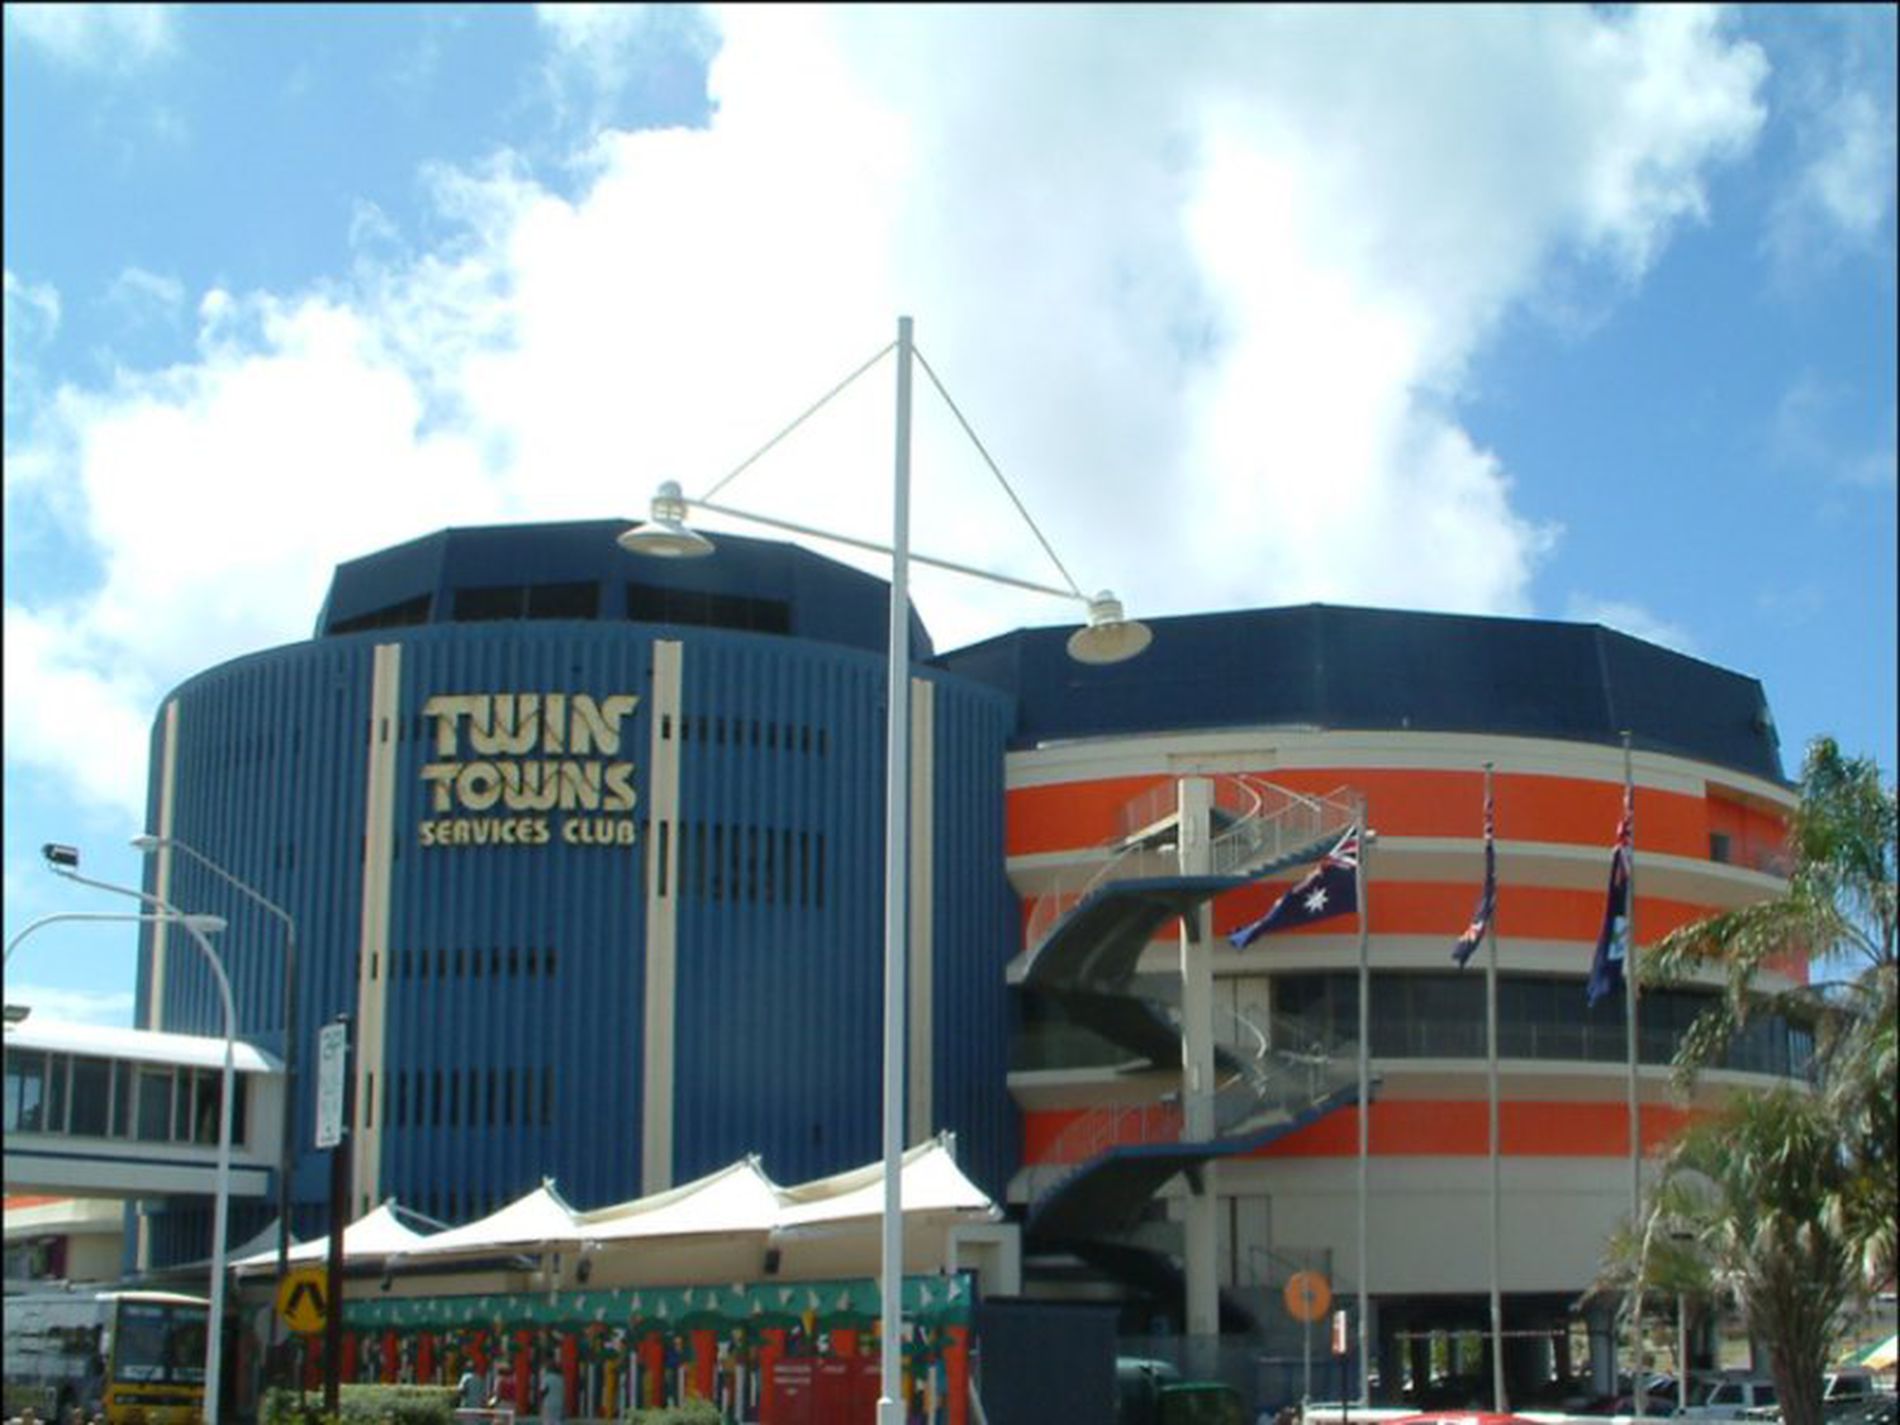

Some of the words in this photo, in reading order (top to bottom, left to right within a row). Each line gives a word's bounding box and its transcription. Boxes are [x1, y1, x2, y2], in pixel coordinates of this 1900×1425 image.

[423, 693, 640, 755] TWIN
[420, 760, 638, 812] TOWNS
[419, 817, 551, 845] SERVICES
[562, 817, 637, 845] CLUB
